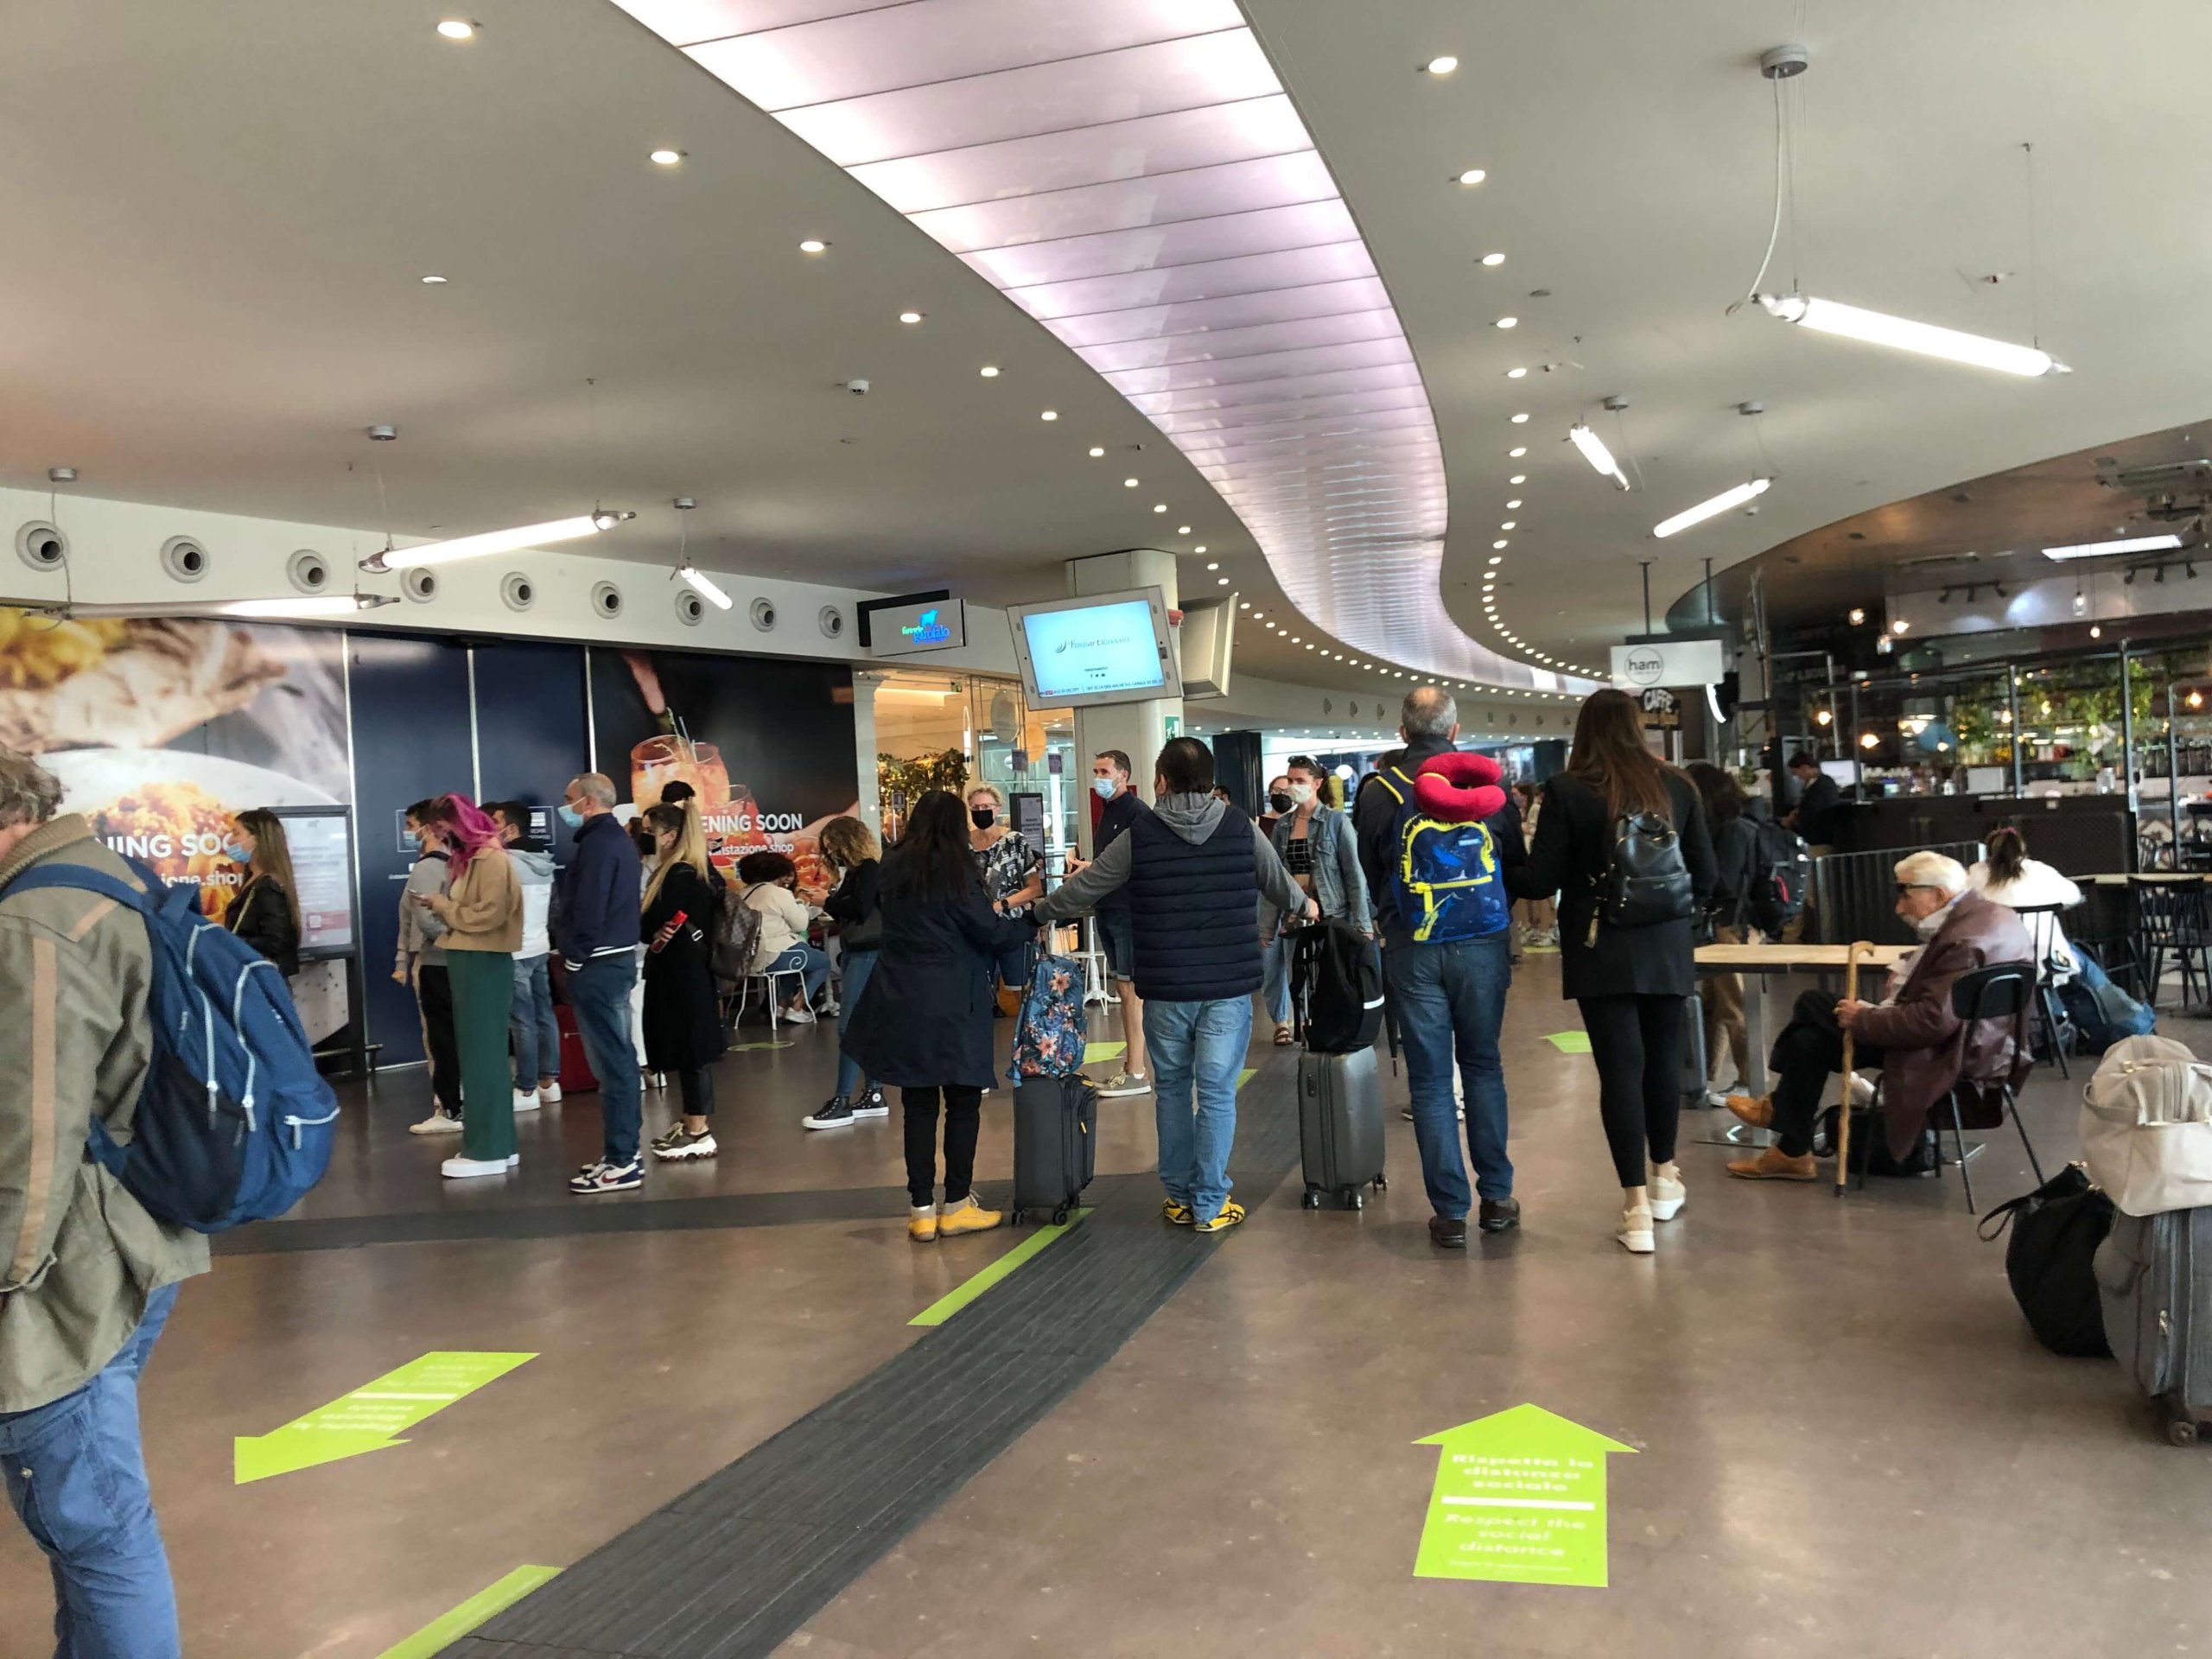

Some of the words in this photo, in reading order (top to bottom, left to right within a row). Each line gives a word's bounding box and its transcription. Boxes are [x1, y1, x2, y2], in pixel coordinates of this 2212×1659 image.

[1629, 658, 1661, 671] ham
[756, 813, 803, 830] SOON
[1452, 1454, 1559, 1466] Rispetta
[1569, 1459, 1594, 1468] la
[1463, 1466, 1580, 1479] distanza
[1472, 1480, 1568, 1491] sociale
[1445, 1513, 1539, 1527] Respect
[1548, 1518, 1586, 1529] the
[1478, 1529, 1551, 1541] social
[1459, 1541, 1566, 1556] distance
